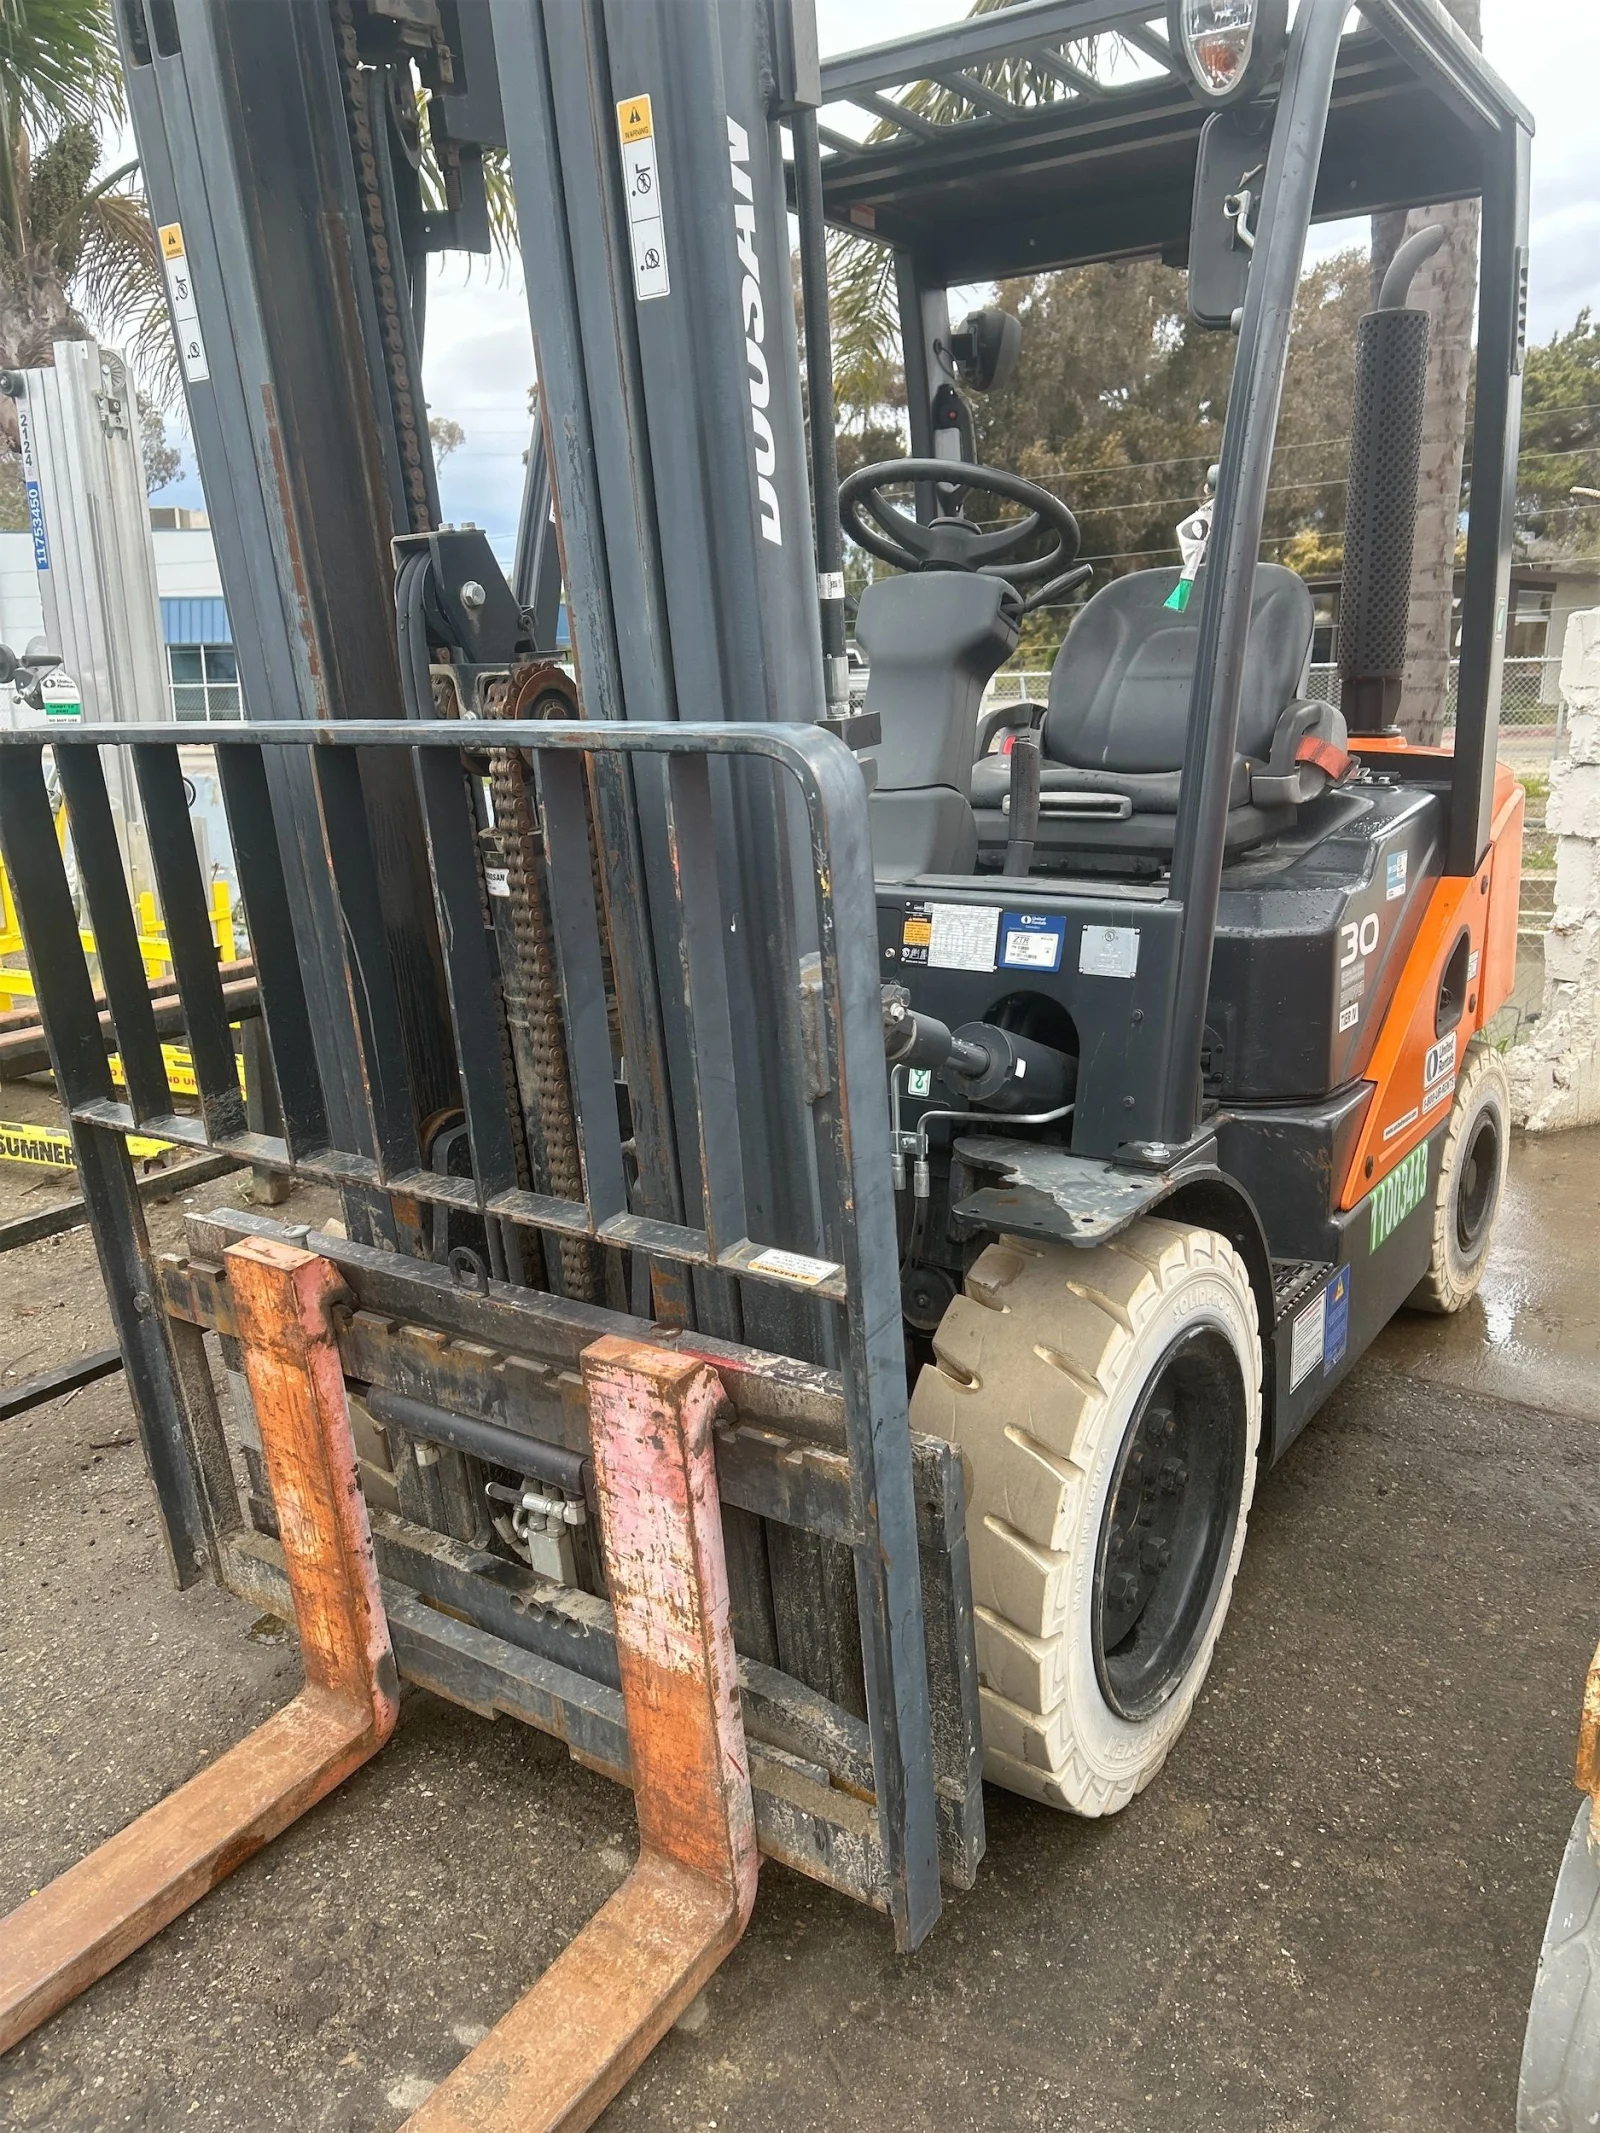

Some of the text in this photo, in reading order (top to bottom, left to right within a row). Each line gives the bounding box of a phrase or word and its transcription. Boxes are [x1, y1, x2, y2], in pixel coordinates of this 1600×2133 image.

[625, 126, 650, 139] WARNING
[28, 488, 47, 564] 11753450
[1012, 935, 1030, 944] ZTR
[1340, 911, 1381, 969] 30
[1371, 1142, 1428, 1251] 11003413
